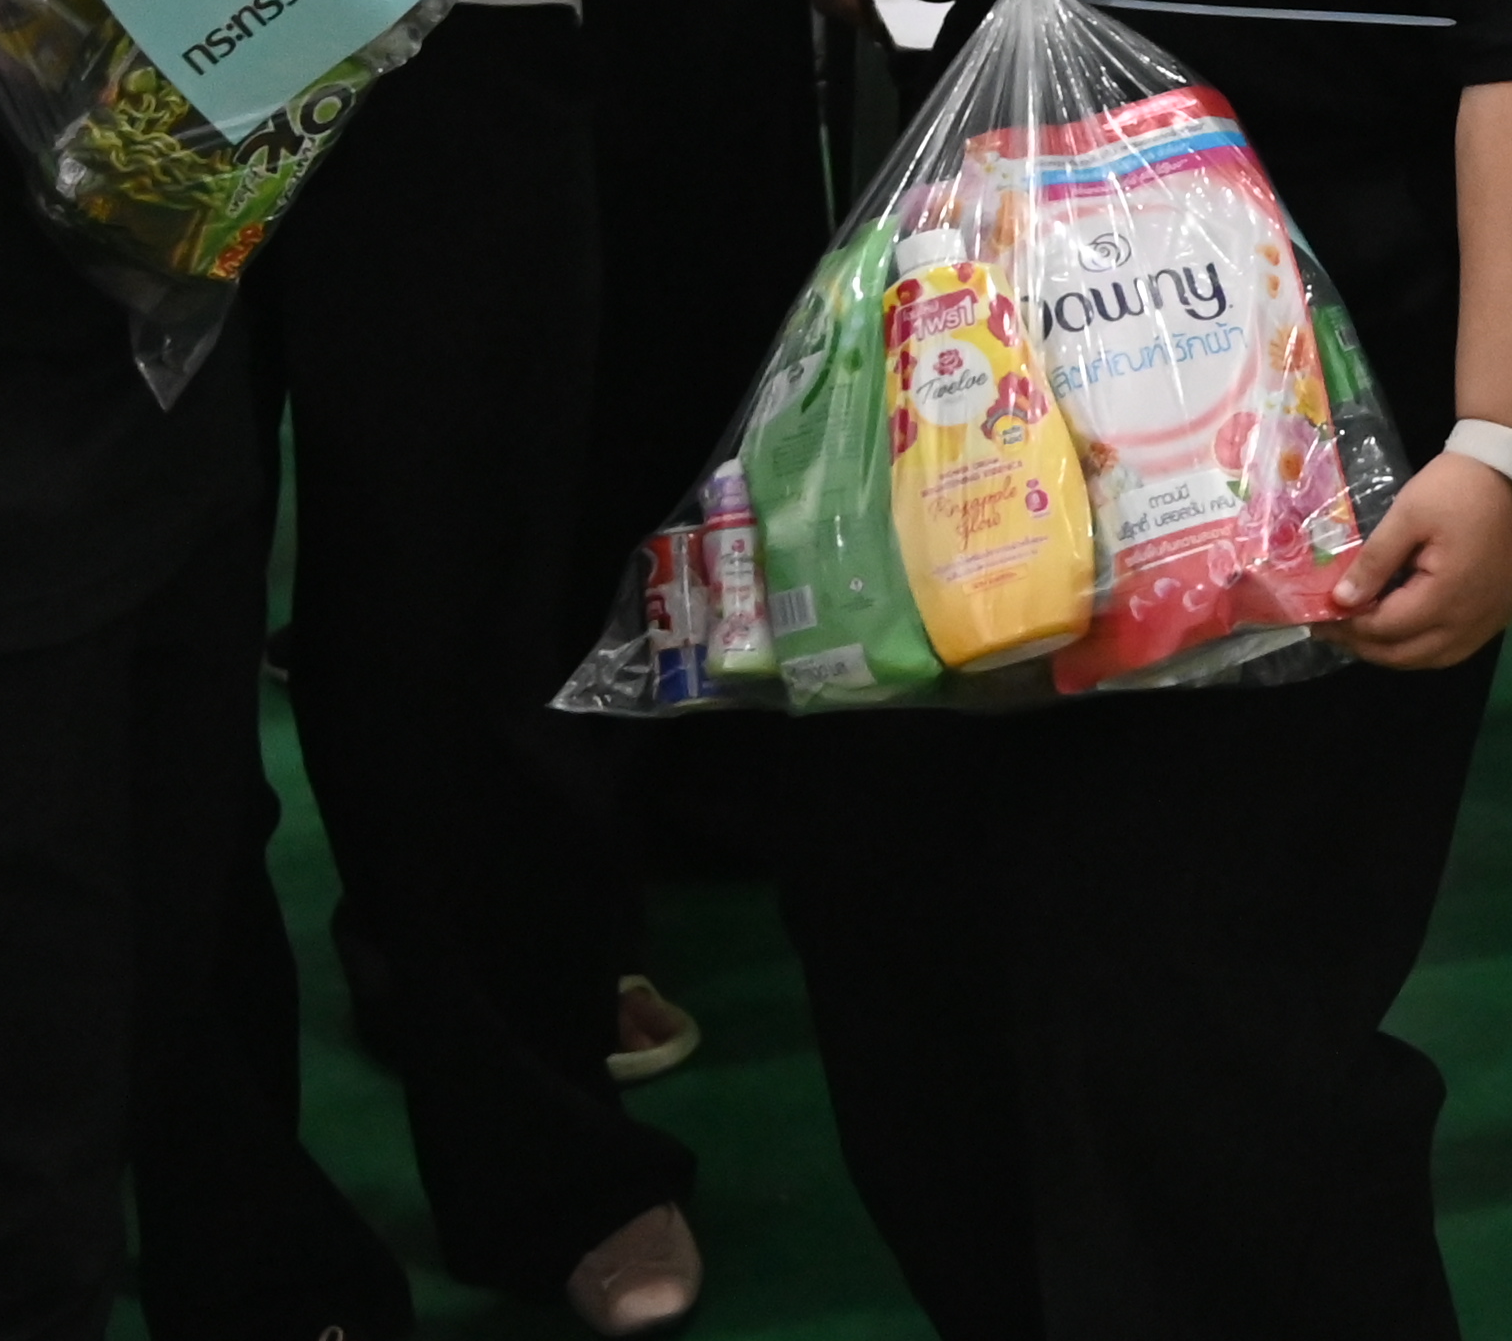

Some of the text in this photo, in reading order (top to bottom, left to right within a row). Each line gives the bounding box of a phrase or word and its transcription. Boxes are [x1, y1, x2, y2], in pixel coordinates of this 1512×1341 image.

[1050, 322, 1248, 400] ลิตภัณฑ์ซักผ้า
